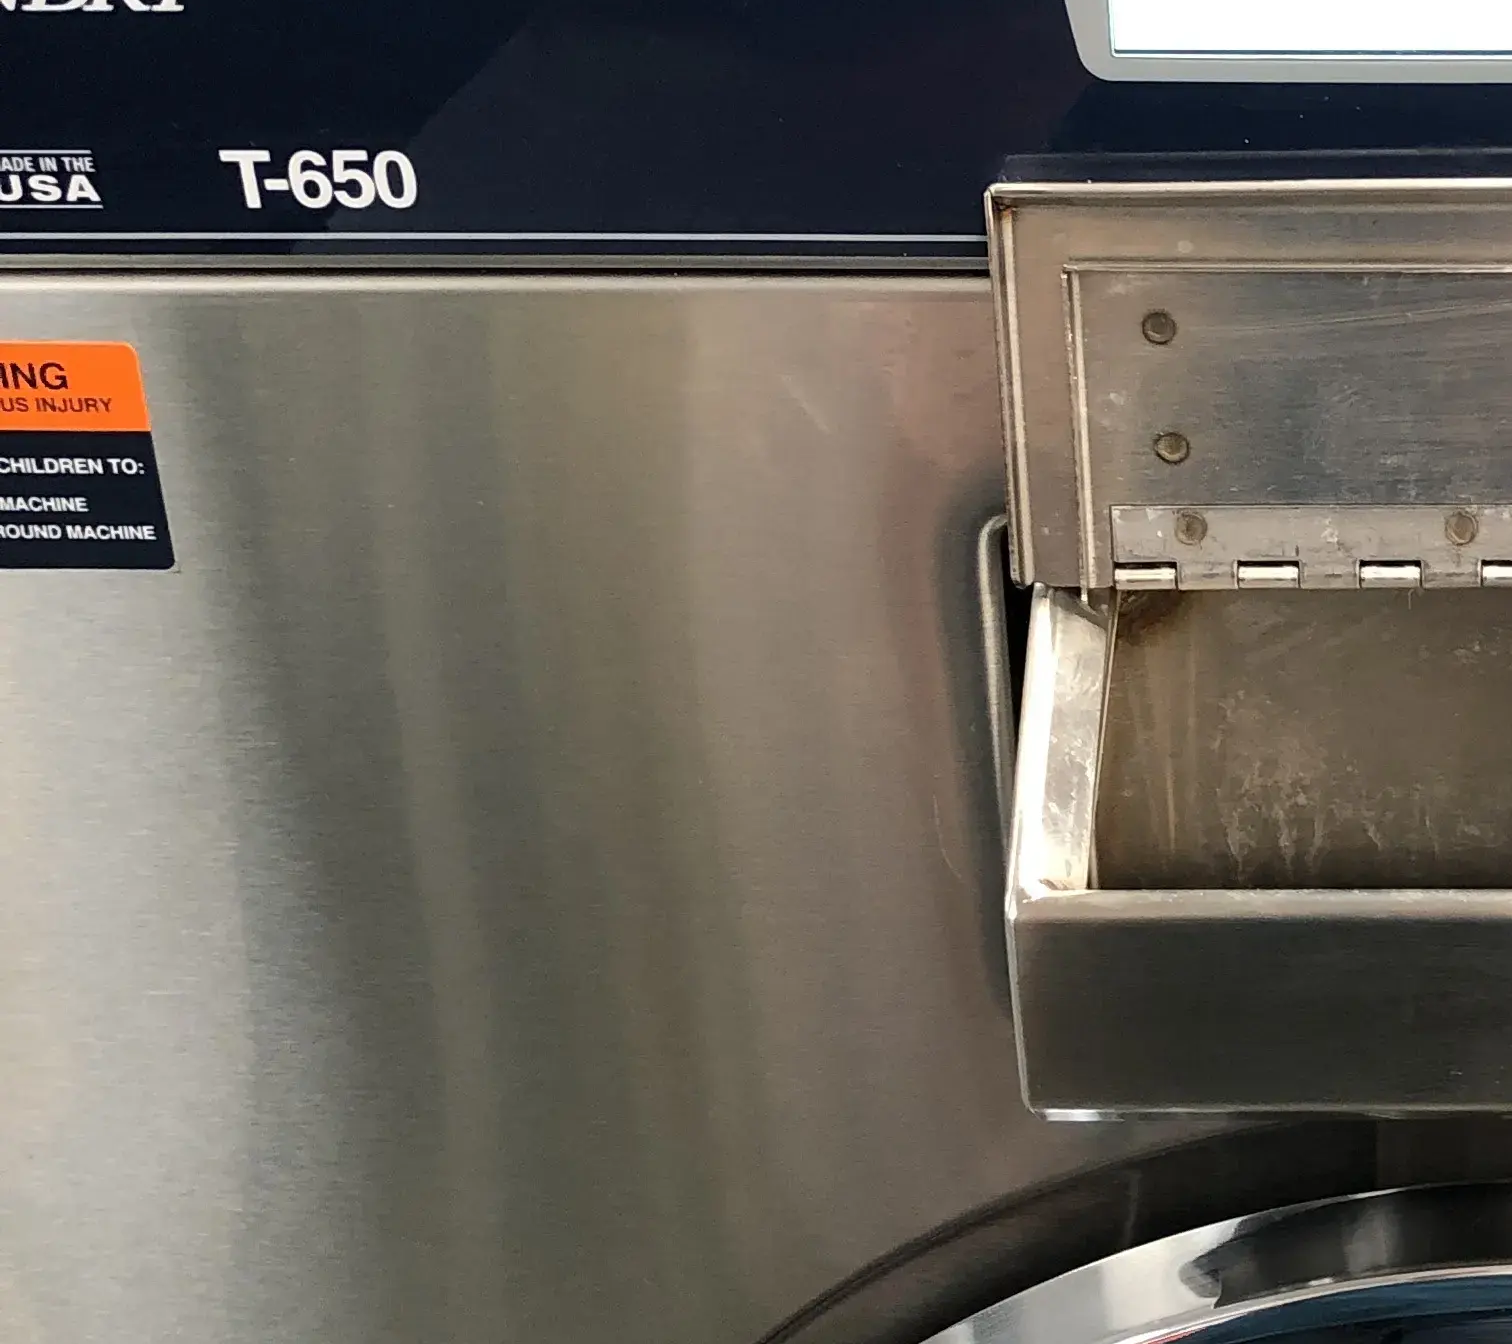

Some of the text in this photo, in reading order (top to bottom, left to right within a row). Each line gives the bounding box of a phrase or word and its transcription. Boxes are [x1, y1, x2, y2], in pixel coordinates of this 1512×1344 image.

[38, 156, 58, 172] IN
[63, 156, 95, 173] THE
[218, 149, 418, 209] T-650
[0, 174, 102, 202] USA
[35, 397, 112, 413] INJURY
[0, 457, 145, 475] CHILDREN TO:
[0, 497, 89, 512] MACHINE
[67, 525, 157, 540] MACHINE
